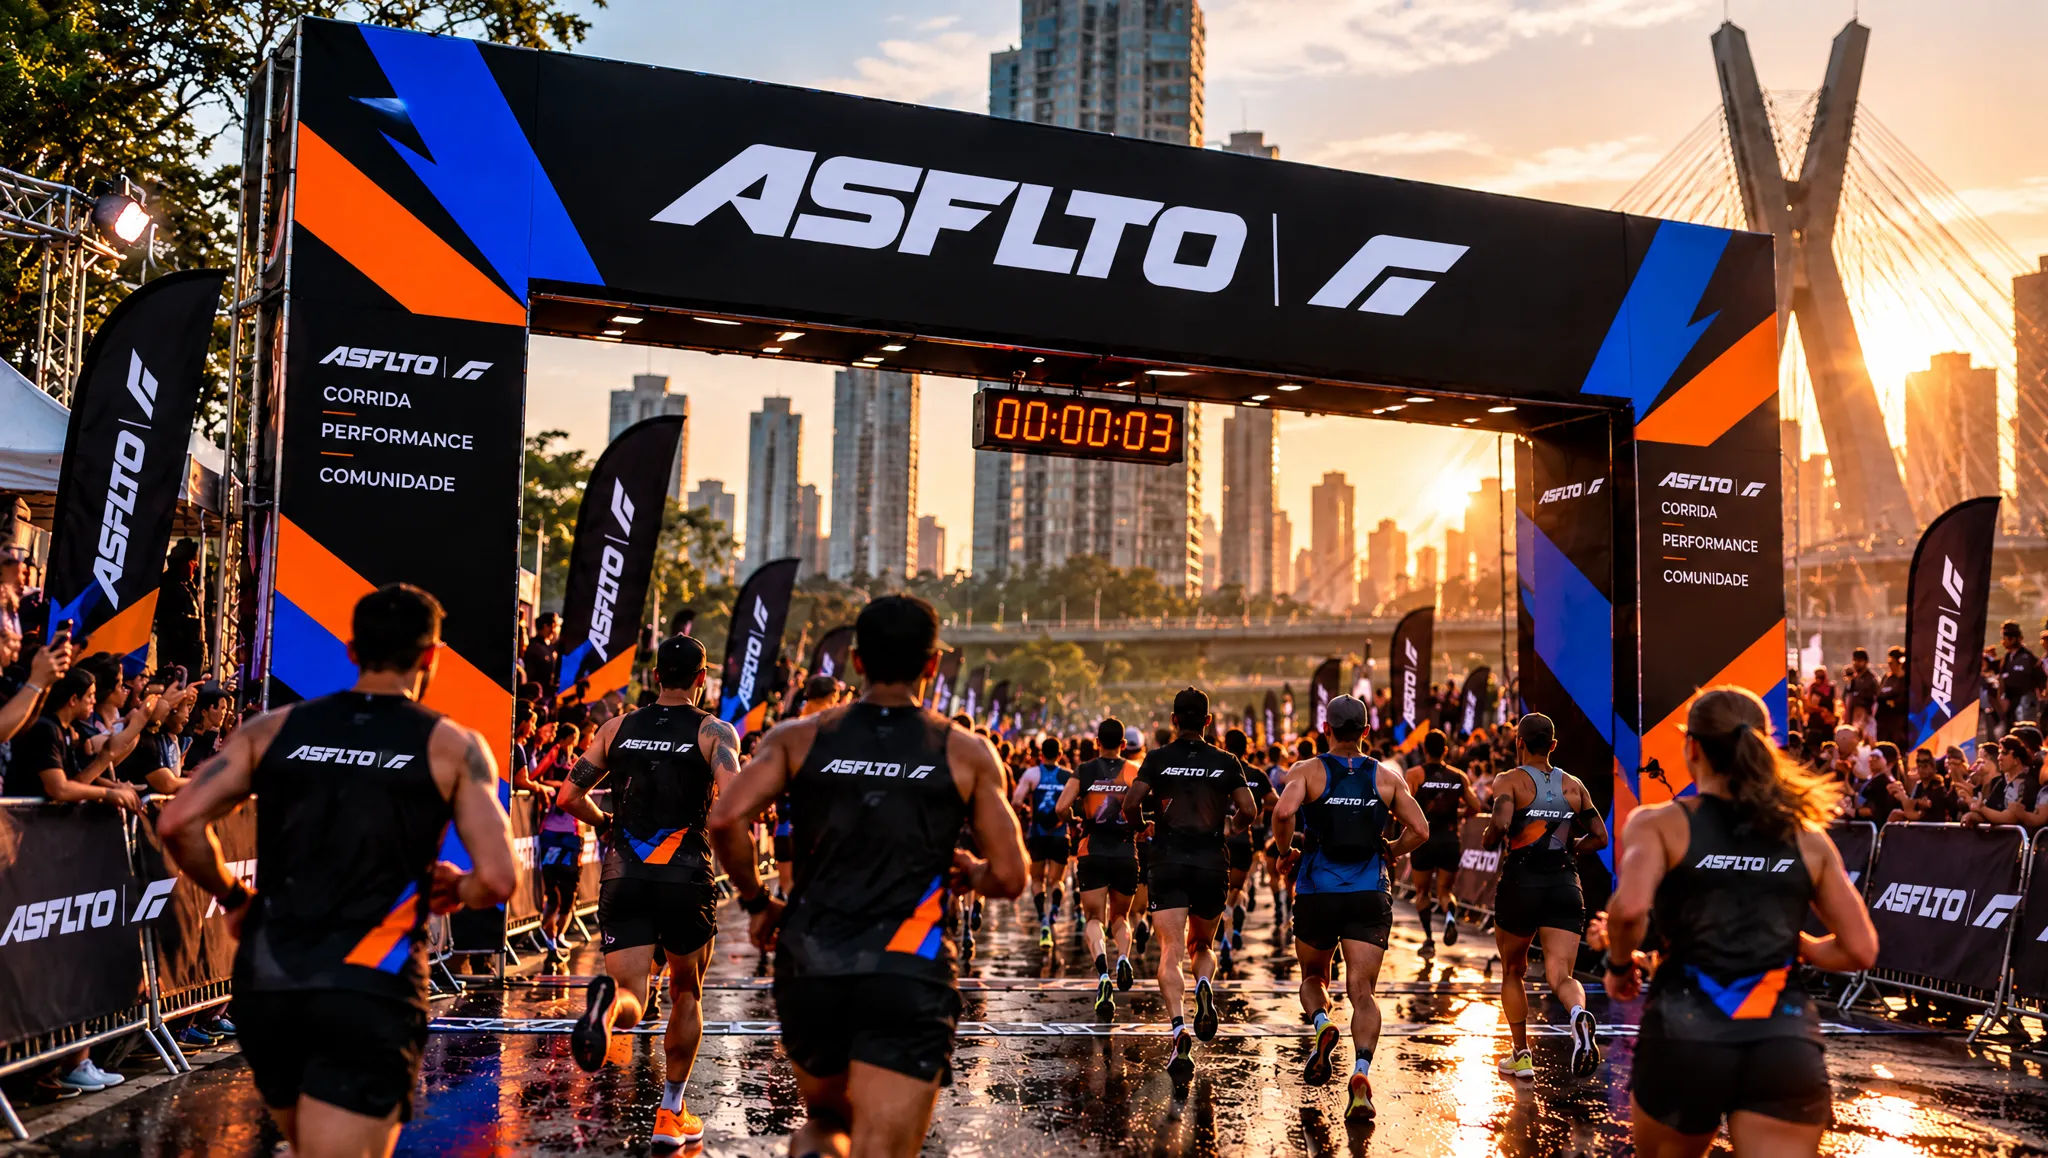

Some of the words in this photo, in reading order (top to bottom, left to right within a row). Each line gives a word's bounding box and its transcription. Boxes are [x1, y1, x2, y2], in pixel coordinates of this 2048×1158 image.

[649, 143, 1248, 292] ASFLTO
[319, 346, 438, 376] ASFLTO
[324, 386, 411, 409] CORRIDA
[321, 422, 473, 451] PERFORMANCE
[995, 398, 1173, 453] 00:00:03
[319, 467, 456, 492] COMUNIDADE
[1659, 472, 1733, 495] ASFLTO
[1538, 483, 1583, 504] ASFLTO
[93, 430, 146, 610] ASFLTO
[1661, 501, 1718, 519] CORRIDA
[1662, 533, 1759, 553] PERFORMANCE
[1663, 569, 1749, 587] COMUNIDADE
[588, 545, 624, 662] ASFLTO
[738, 636, 762, 712] ASFLTO
[1931, 615, 1959, 719] ASFLTO
[286, 745, 377, 766] ASFLTO
[618, 738, 672, 751] ASFLTO
[820, 759, 901, 777] ASFLTO
[1160, 767, 1205, 777] ASFLTO
[1324, 797, 1362, 806] ASFLTO
[1525, 809, 1560, 818] ASFLTO
[1695, 854, 1766, 871] ASFLTO
[1873, 882, 1967, 922] ASFLTO
[0, 889, 117, 946] ASFLTO
